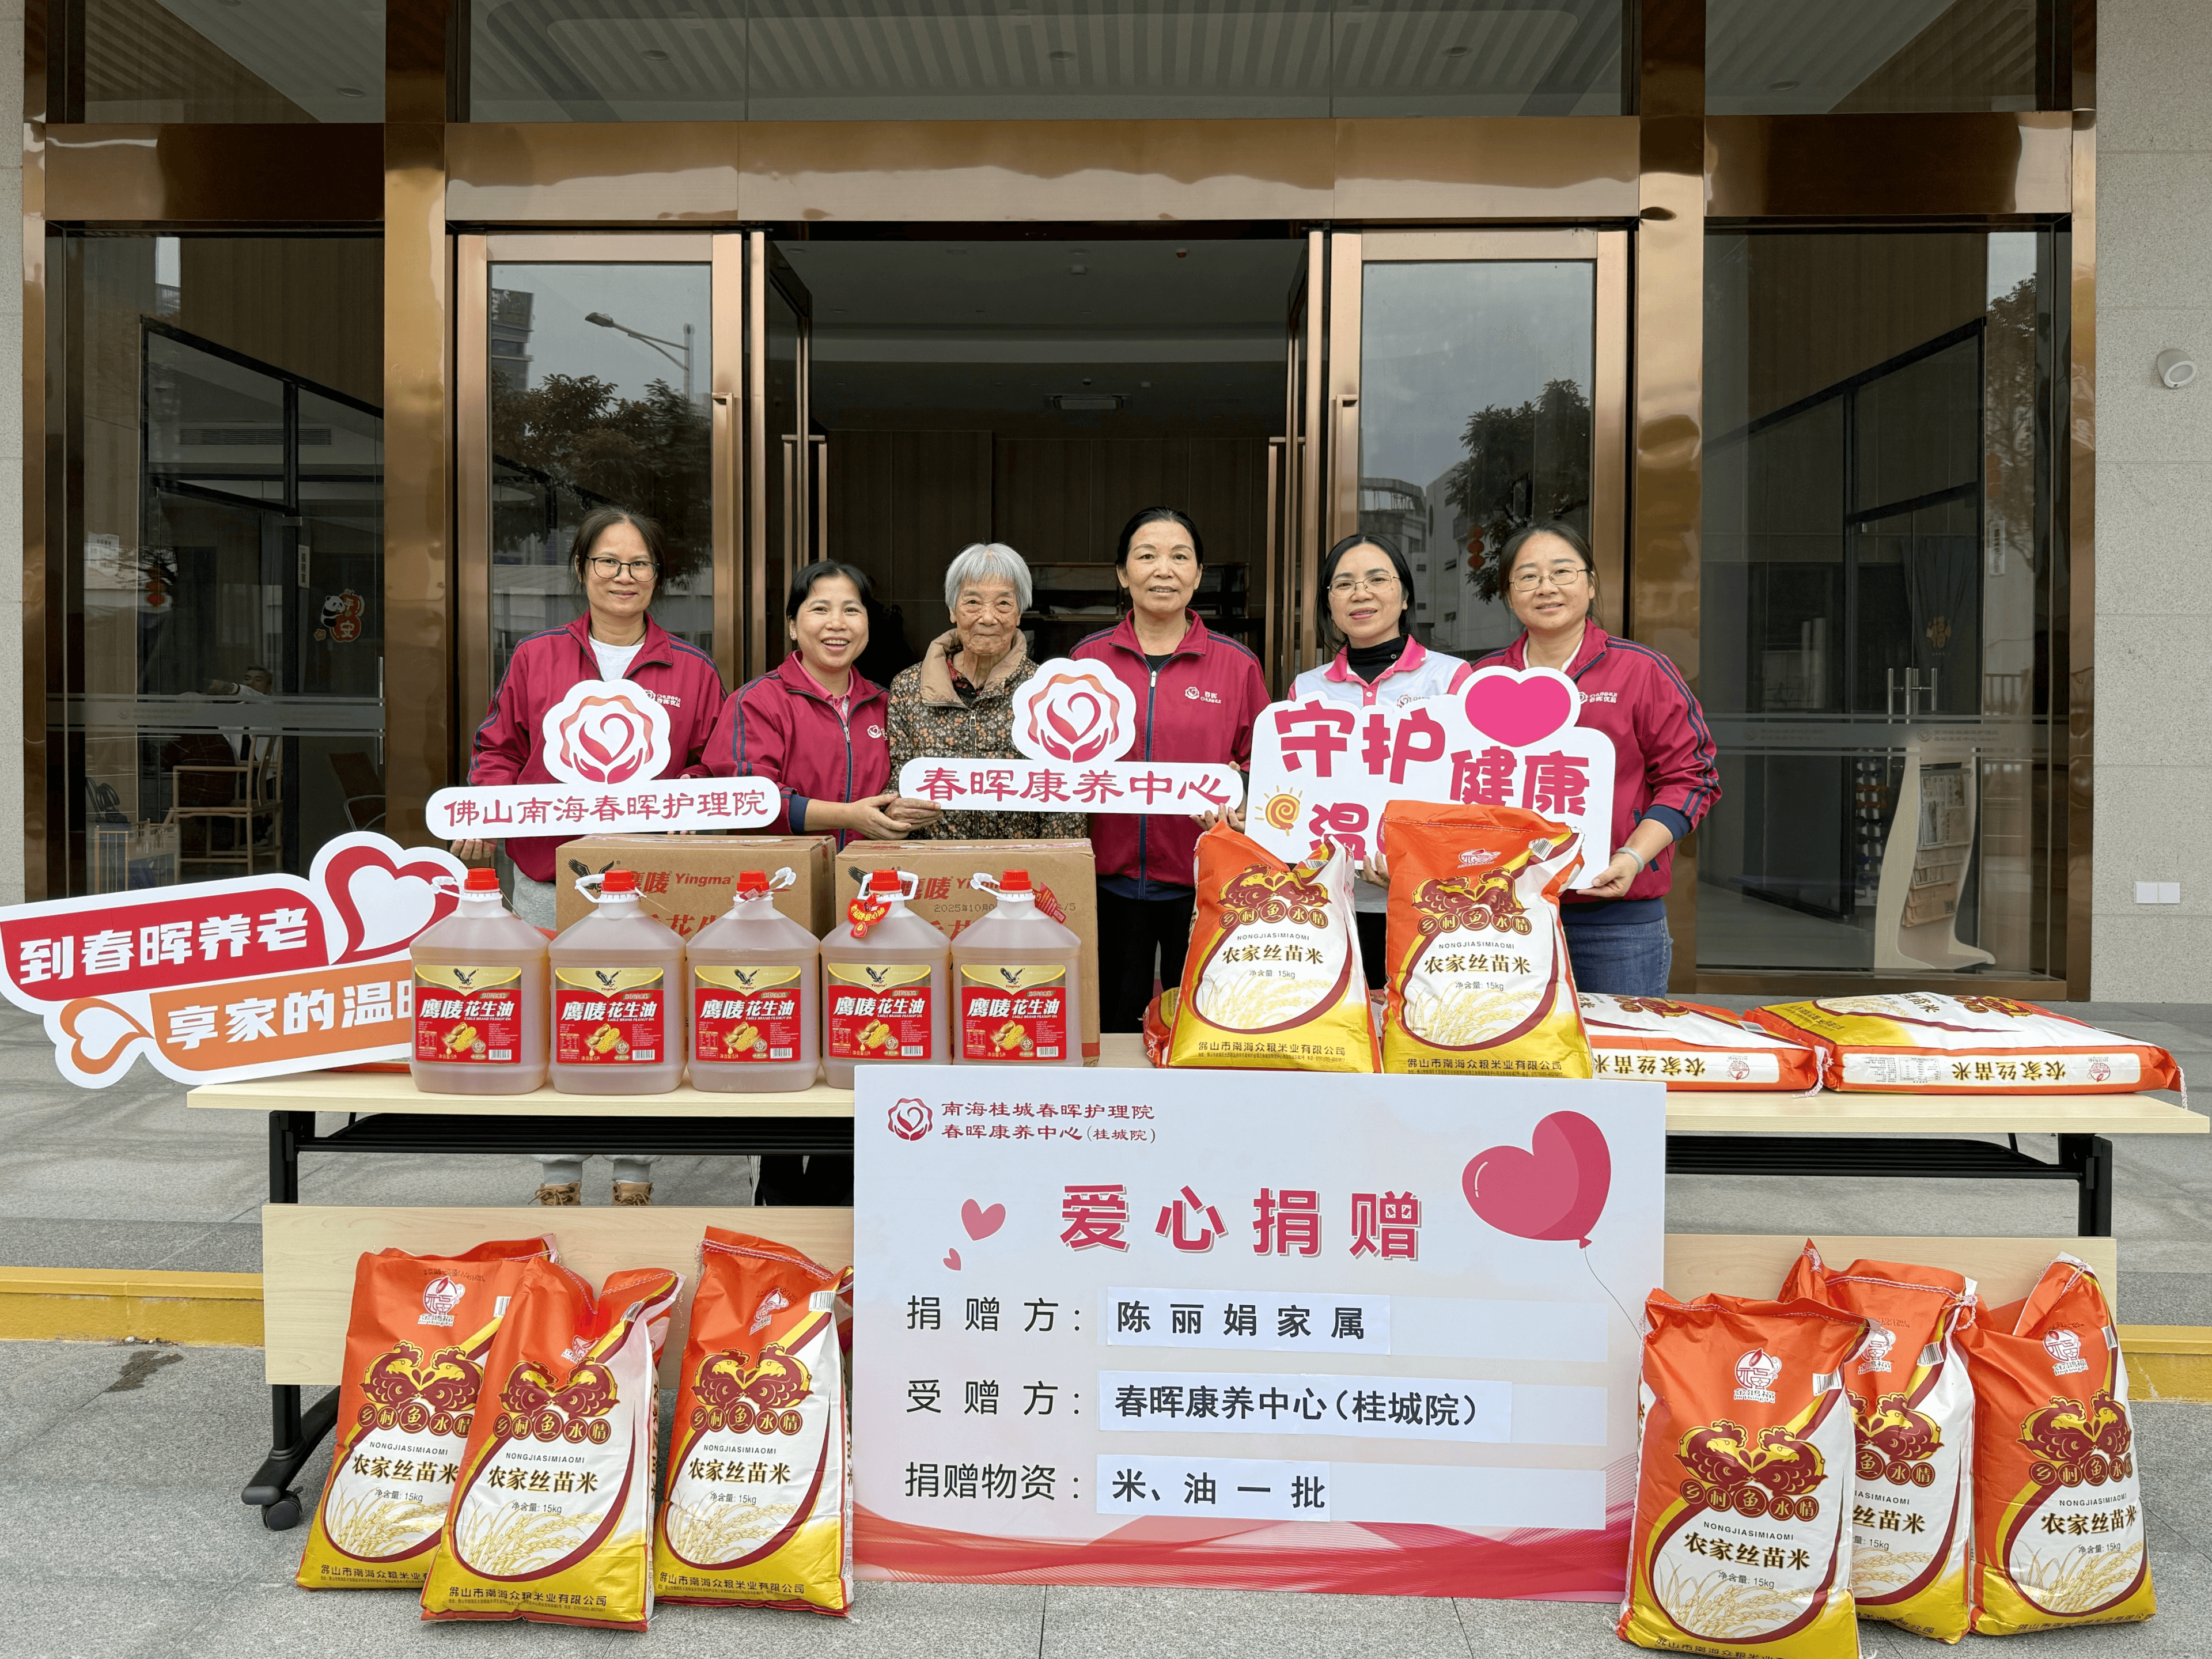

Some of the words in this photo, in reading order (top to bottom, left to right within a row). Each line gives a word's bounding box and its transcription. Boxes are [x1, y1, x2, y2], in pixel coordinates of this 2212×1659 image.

[1274, 699, 1445, 785] 守护
[916, 767, 1231, 805] 春晖康养中心
[1450, 745, 1590, 816] 健康
[444, 790, 768, 827] 佛山南海春晖护理院
[1309, 802, 1384, 861] 温
[675, 873, 732, 887] Yingma
[1222, 902, 1325, 926] 乡村鱼水情
[1421, 910, 1530, 932] 乡村鱼水情
[20, 908, 308, 985] 到春晖养老
[1222, 945, 1324, 965] 农家丝苗米
[1278, 971, 1296, 979] 15kg
[1425, 954, 1532, 975] 农家丝苗米
[1486, 982, 1504, 991] 15kg
[1593, 1054, 1706, 1076] 农家丝苗米
[1951, 1061, 2066, 1081] 农家丝苗米
[941, 1101, 1155, 1120] 南海桂城春晖护理院
[941, 1124, 1156, 1143] 春晖康养中心（桂城院）
[1059, 1183, 1422, 1261] 爱心捐赠
[907, 1294, 1080, 1332] 捐赠方：
[1118, 1300, 1365, 1339] 陈丽娟家属
[906, 1378, 1080, 1415] 受赠方：
[1115, 1384, 1476, 1426] 春晖康养中心（桂城院）
[361, 1408, 471, 1433] 乡村鱼水情
[496, 1414, 608, 1440] 乡村鱼水情
[694, 1406, 800, 1431] 乡村鱼水情
[353, 1453, 459, 1485] 农家丝苗米
[487, 1465, 599, 1494] 农家丝苗米
[688, 1457, 791, 1485] 农家丝苗米
[1856, 1453, 1933, 1484] 鱼水情
[2035, 1456, 2131, 1481] 乡村鱼水情
[905, 1461, 1078, 1501] 捐赠物资：
[1112, 1468, 1325, 1509] 米、油一批
[404, 1493, 423, 1503] 15kg
[543, 1503, 562, 1515] 15kg
[738, 1494, 757, 1505] 15kg
[1684, 1483, 1816, 1518] 乡村鱼水情
[1854, 1490, 1910, 1506] IASIMIAOMI
[1853, 1505, 1926, 1535] 丝苗米
[2041, 1505, 2137, 1536] 农家丝苗米
[1684, 1531, 1810, 1571] 农家丝苗米
[1853, 1535, 1866, 1546] 量:
[1869, 1538, 1889, 1551] 15kg
[2107, 1542, 2121, 1551] 15kg
[1753, 1578, 1775, 1590] 15kg
